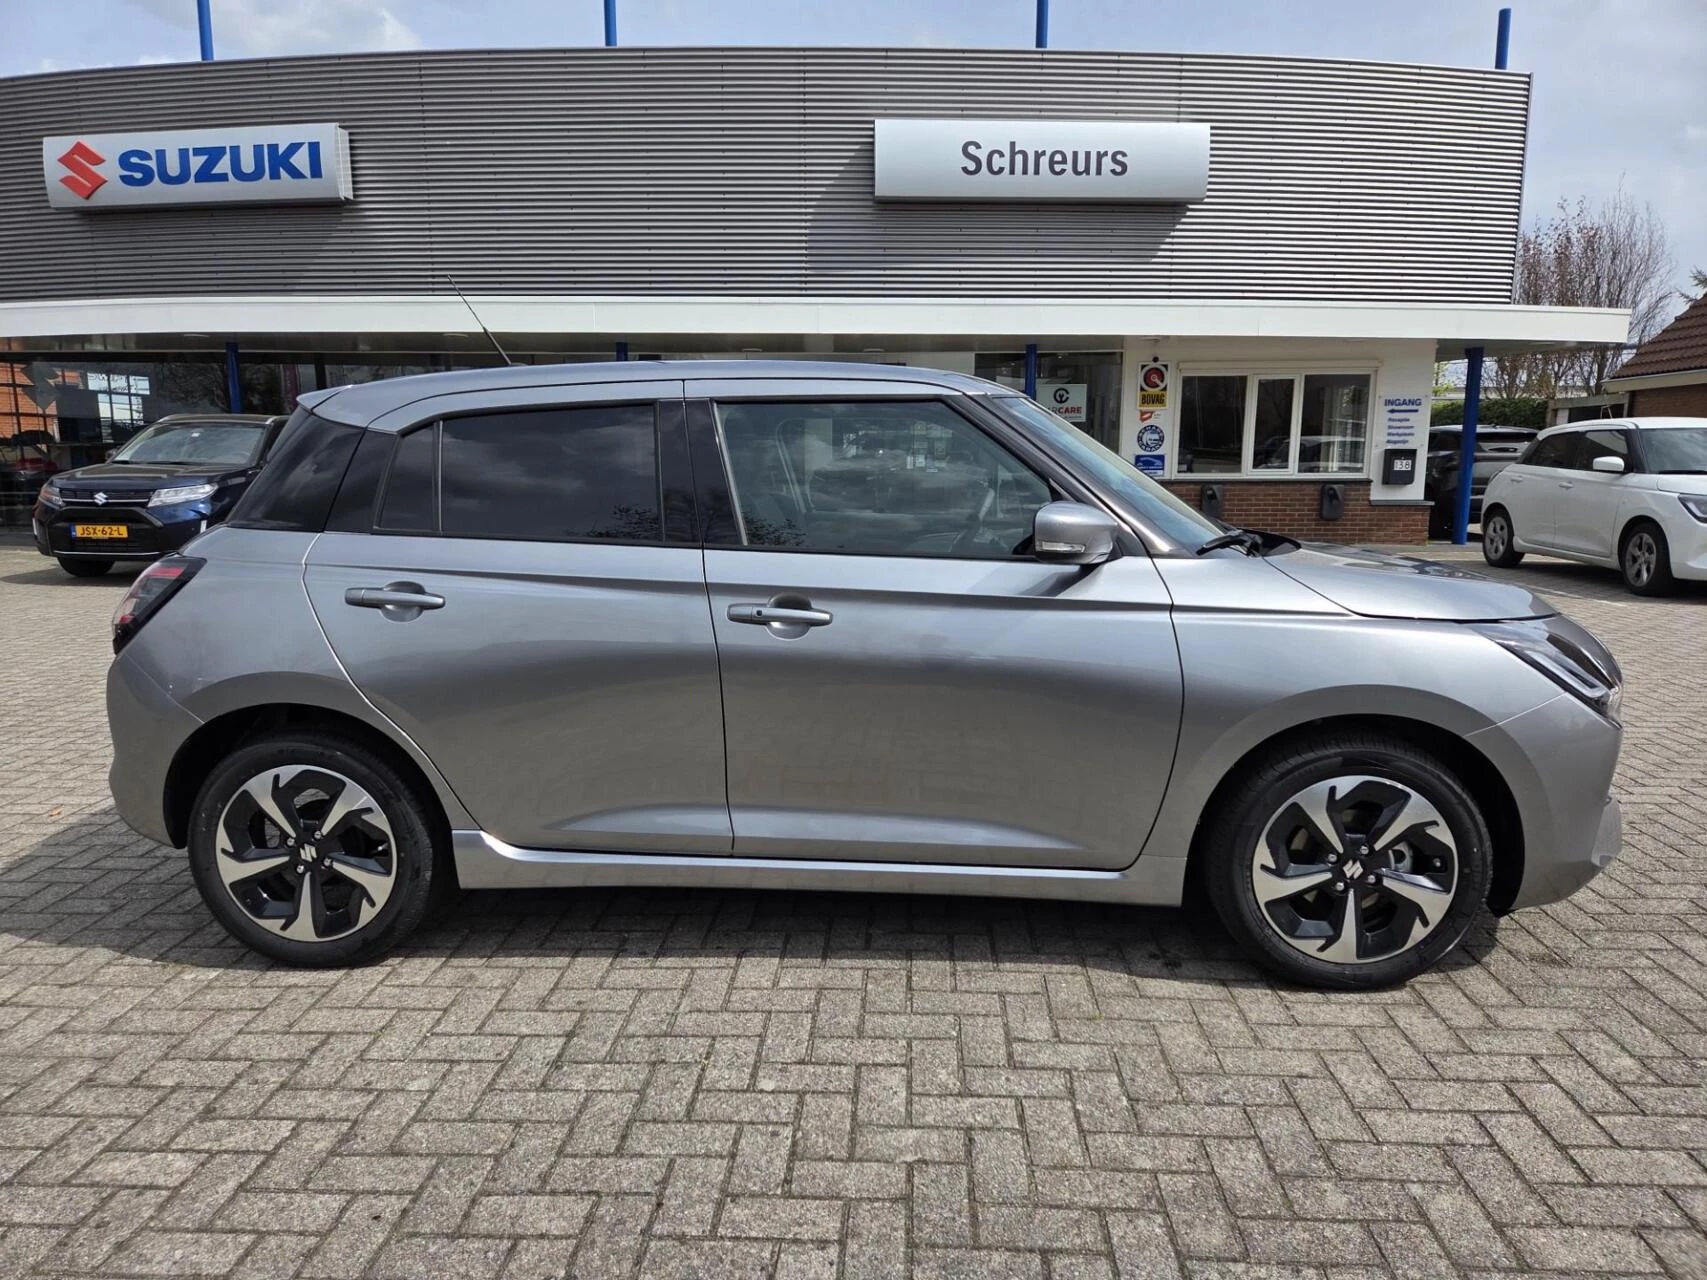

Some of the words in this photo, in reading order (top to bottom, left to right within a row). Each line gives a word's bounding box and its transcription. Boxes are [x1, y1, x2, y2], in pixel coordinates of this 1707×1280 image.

[961, 140, 1128, 176] Schreurs
[118, 141, 323, 187] SUZUKI
[1141, 393, 1165, 405] BOVAG
[1384, 398, 1422, 407] INGANG
[1395, 460, 1411, 470] 138
[80, 526, 124, 536] JSX-62-L
